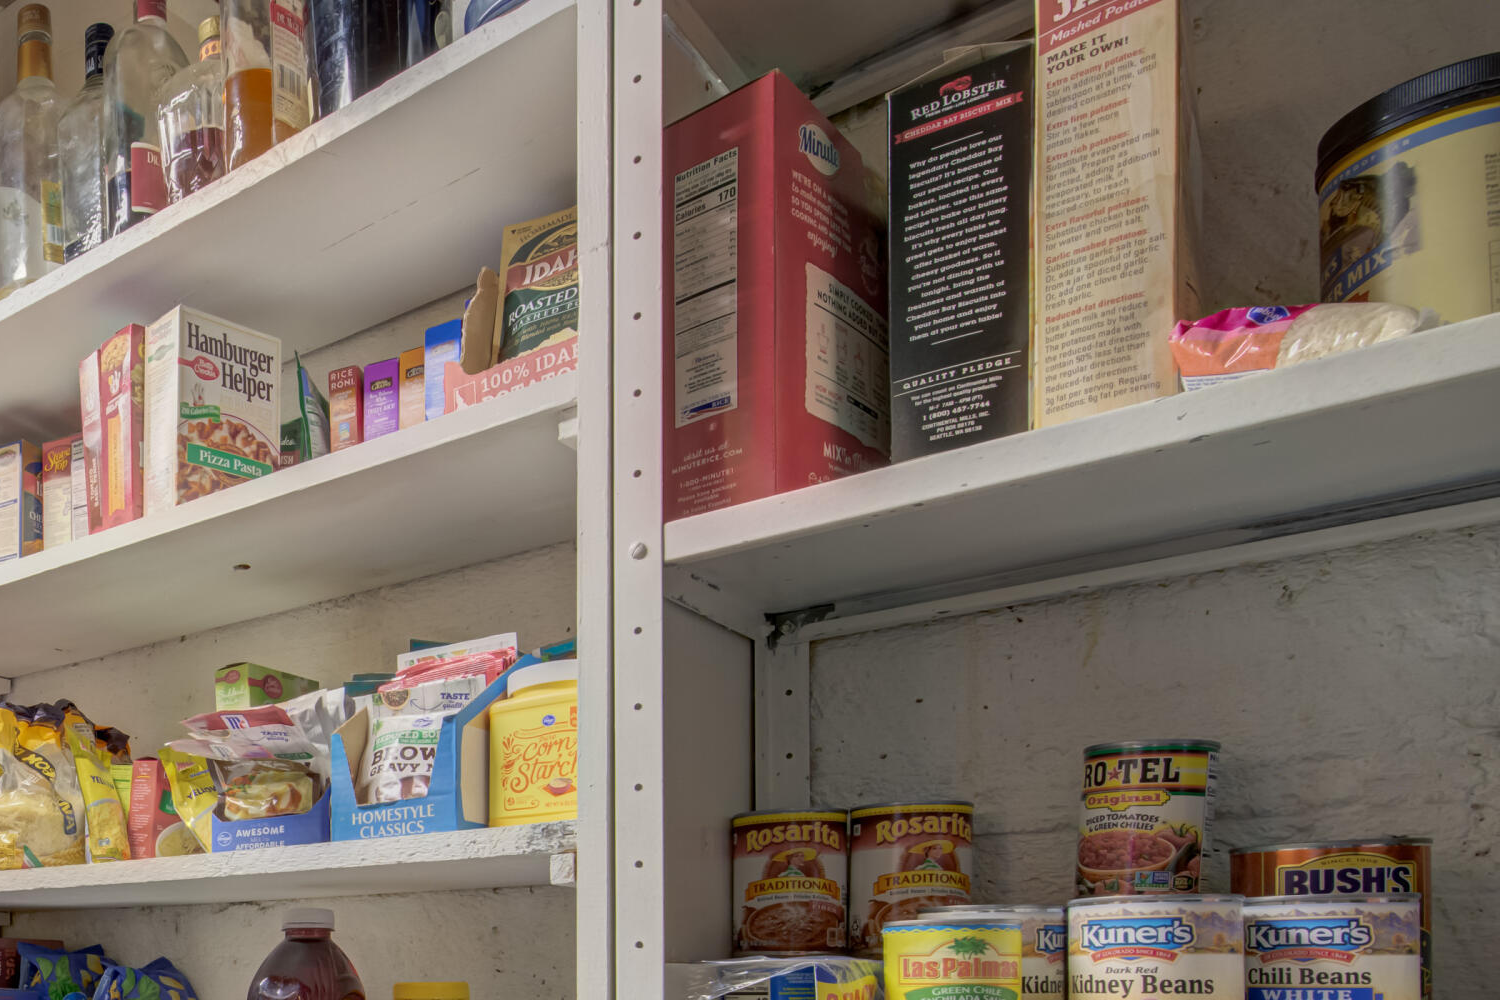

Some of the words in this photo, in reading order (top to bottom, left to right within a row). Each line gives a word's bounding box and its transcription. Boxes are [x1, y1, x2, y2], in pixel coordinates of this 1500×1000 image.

[1050, 12, 1101, 45] Mashed
[1047, 40, 1087, 65] MAKE
[1091, 33, 1107, 46] IT
[1047, 54, 1085, 75] YOUR
[1089, 36, 1129, 58] OWN!
[911, 101, 940, 120] RED
[942, 80, 1006, 106] LOBSTER
[904, 122, 941, 139] CHEDDAR
[943, 115, 957, 125] BAY
[960, 104, 991, 119] BISCUIT
[995, 97, 1012, 107] MIX
[800, 127, 839, 167] Minute
[676, 162, 711, 183] Nutrition
[713, 150, 737, 165] Facts
[675, 203, 706, 222] Calories
[718, 186, 736, 203] 170
[1347, 250, 1387, 287] MIX
[508, 287, 577, 327] ROASTED
[188, 322, 273, 378] Hamburger
[221, 362, 273, 403] Helper
[331, 368, 353, 380] RICE
[481, 362, 529, 393] 100%
[903, 370, 956, 390] QUALITY
[962, 357, 1012, 374] PLEDGE
[199, 449, 230, 469] Pizza
[233, 458, 262, 477] Pasta
[440, 692, 470, 700] TASTE
[1088, 793, 1161, 806] Original
[352, 804, 436, 826] HOMESTYLE
[876, 814, 973, 844] Rosarita
[1094, 822, 1118, 831] GREEN
[1120, 822, 1154, 831] CHILIES
[1106, 813, 1159, 823] TOMATOES
[235, 825, 285, 838] AWESOME
[359, 821, 425, 839] CLASSICS
[746, 821, 840, 851] Rosarita
[753, 880, 834, 893] TRADITIONAL
[885, 872, 967, 887] TRADITIONAL
[1284, 866, 1413, 895] BUSH'S
[1082, 920, 1192, 948] Kuner's
[1249, 920, 1371, 948] Kuner's
[1105, 967, 1131, 975] Dark
[1135, 967, 1158, 975] Red
[1248, 968, 1292, 985] Chili
[1300, 969, 1372, 985] Beans
[931, 986, 970, 996] GREEN
[972, 985, 1003, 997] CHILE
[1071, 975, 1134, 999] Kidney
[1141, 974, 1214, 994] Beans
[1261, 989, 1353, 1000] WHITE
